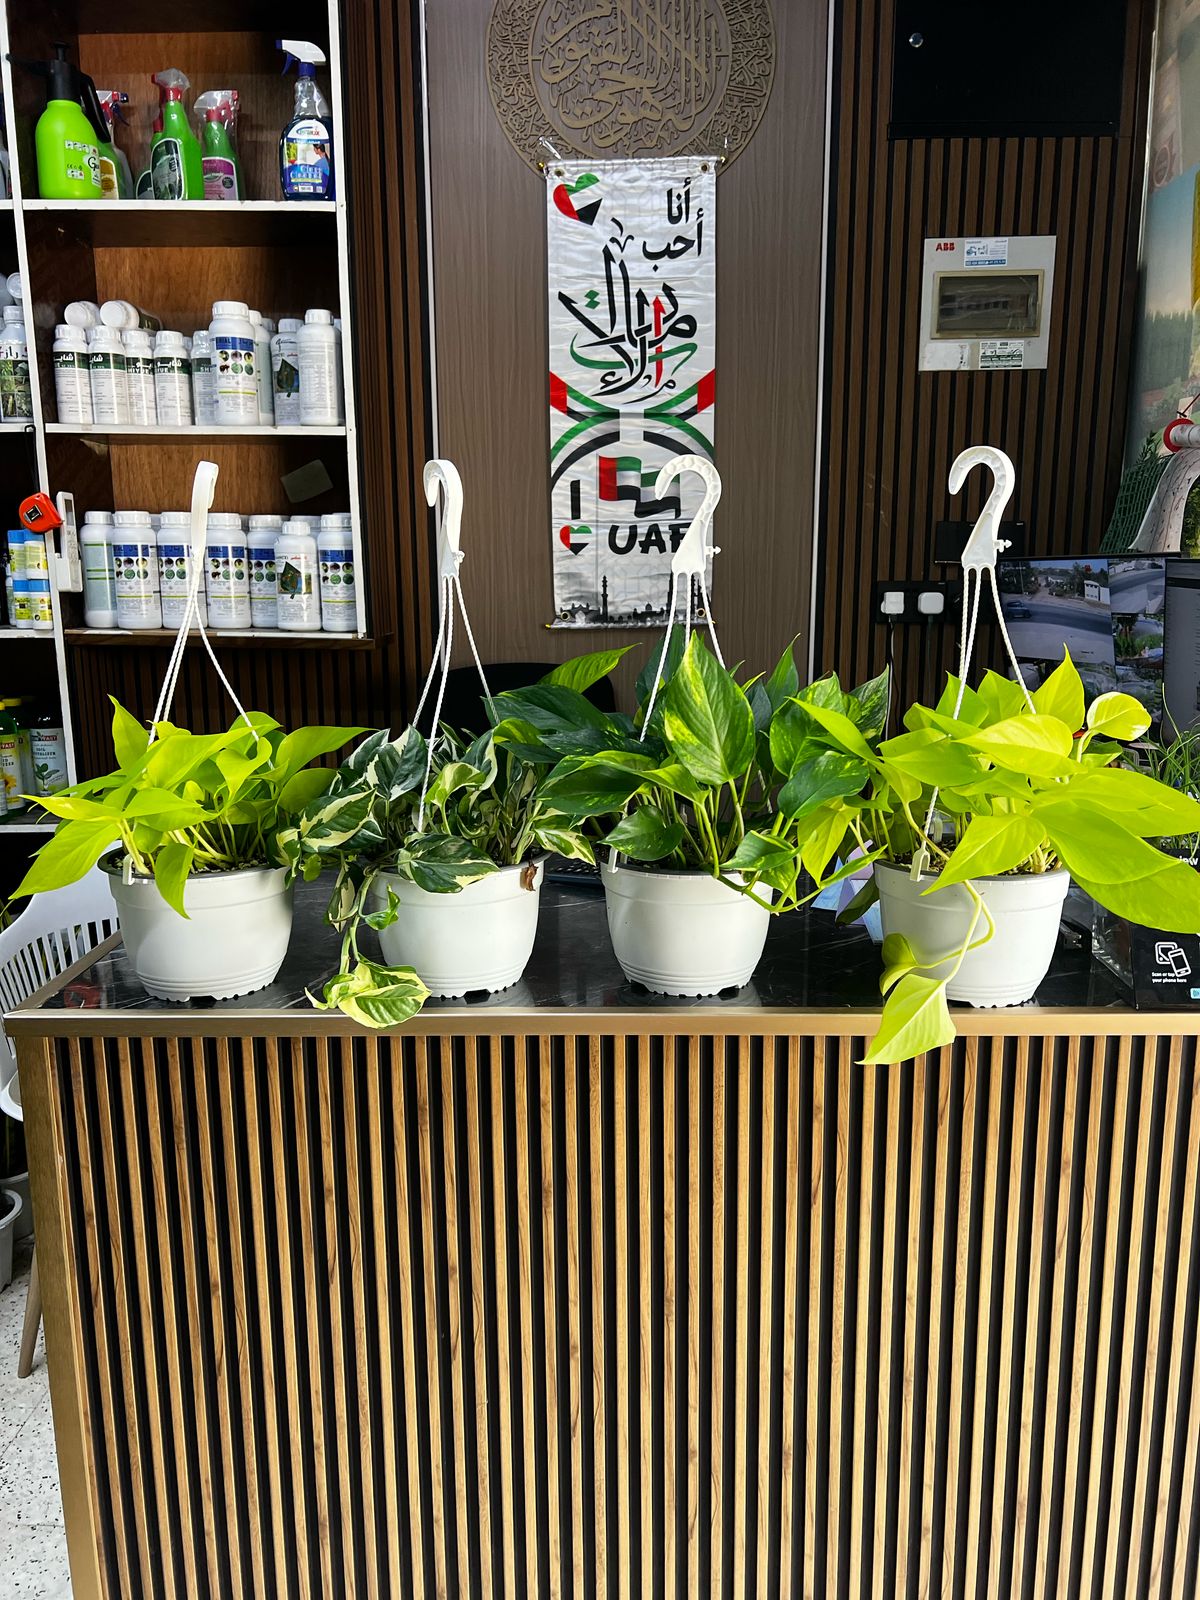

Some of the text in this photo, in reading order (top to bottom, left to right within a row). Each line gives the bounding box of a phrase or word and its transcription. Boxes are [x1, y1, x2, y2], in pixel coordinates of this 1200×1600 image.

[666, 176, 692, 225] أنا
[641, 207, 705, 273] أحب
[935, 242, 955, 251] ABB
[569, 479, 581, 520] I
